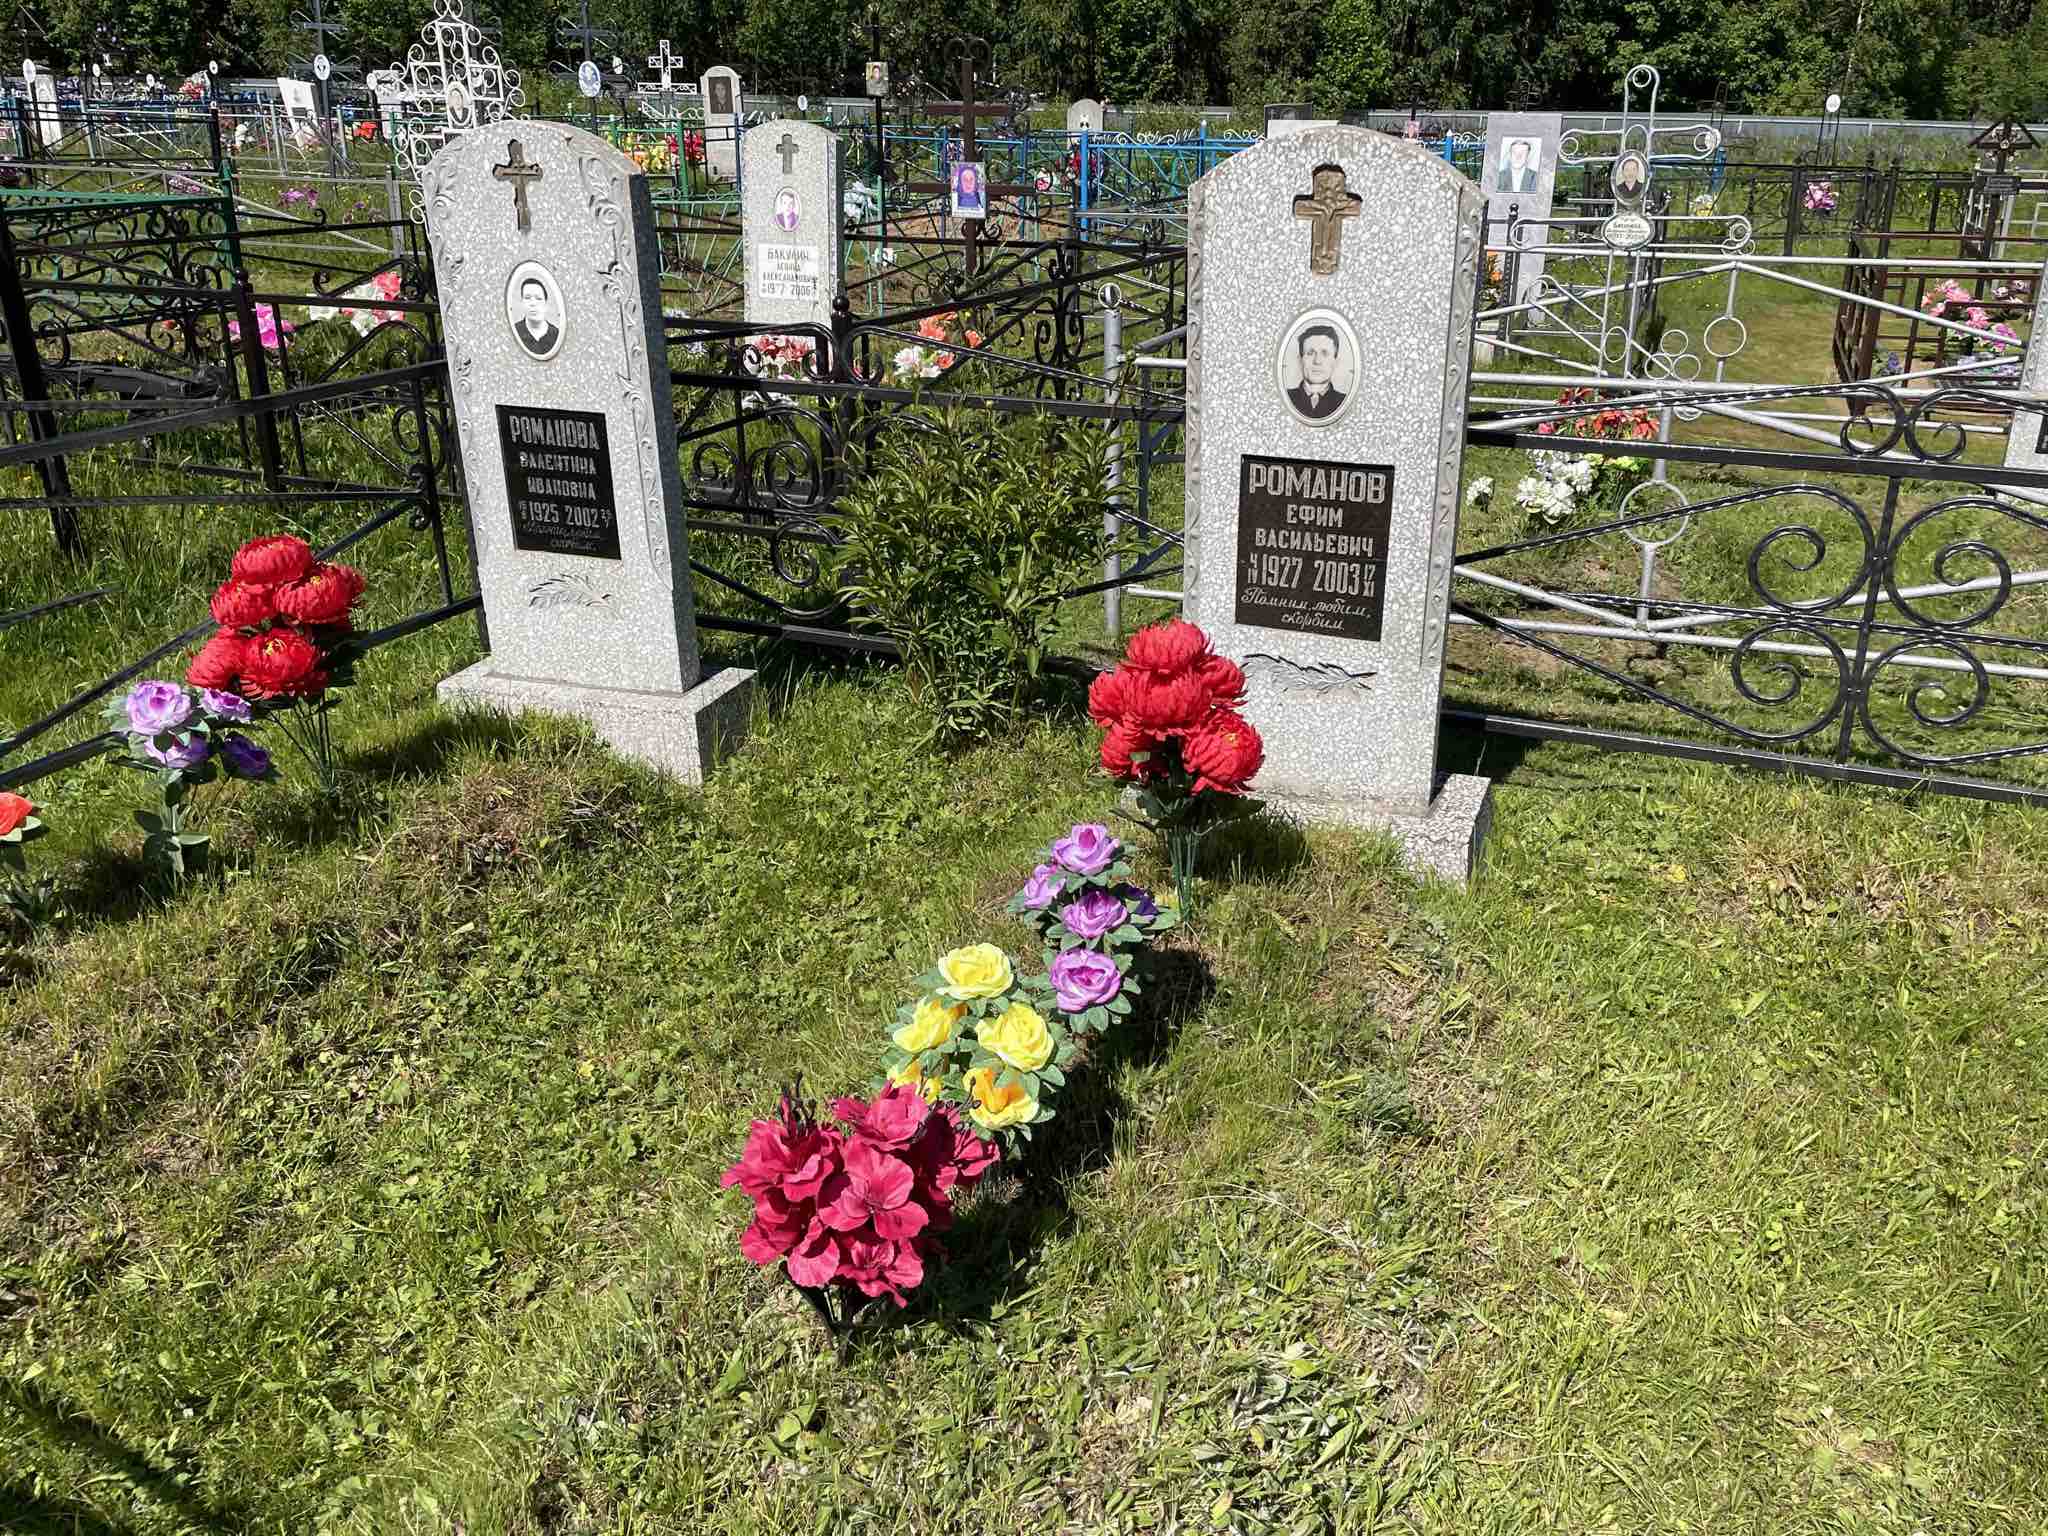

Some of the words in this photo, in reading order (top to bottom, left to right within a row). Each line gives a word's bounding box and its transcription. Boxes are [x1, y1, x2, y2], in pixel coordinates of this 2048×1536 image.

[509, 415, 600, 449] РОМАНОВА
[519, 451, 597, 474] ВАЛЕНТИНА
[527, 476, 596, 500] ИВАНОВНА
[1249, 463, 1386, 503] РОМАНОВ
[528, 501, 559, 523] 1925
[565, 505, 600, 528] 2002
[1286, 504, 1344, 527] ЕФИМ
[1255, 528, 1374, 557] ВАСИЛЬЕВИЧ
[1261, 554, 1303, 588] 1927
[1312, 560, 1361, 595] 2003
